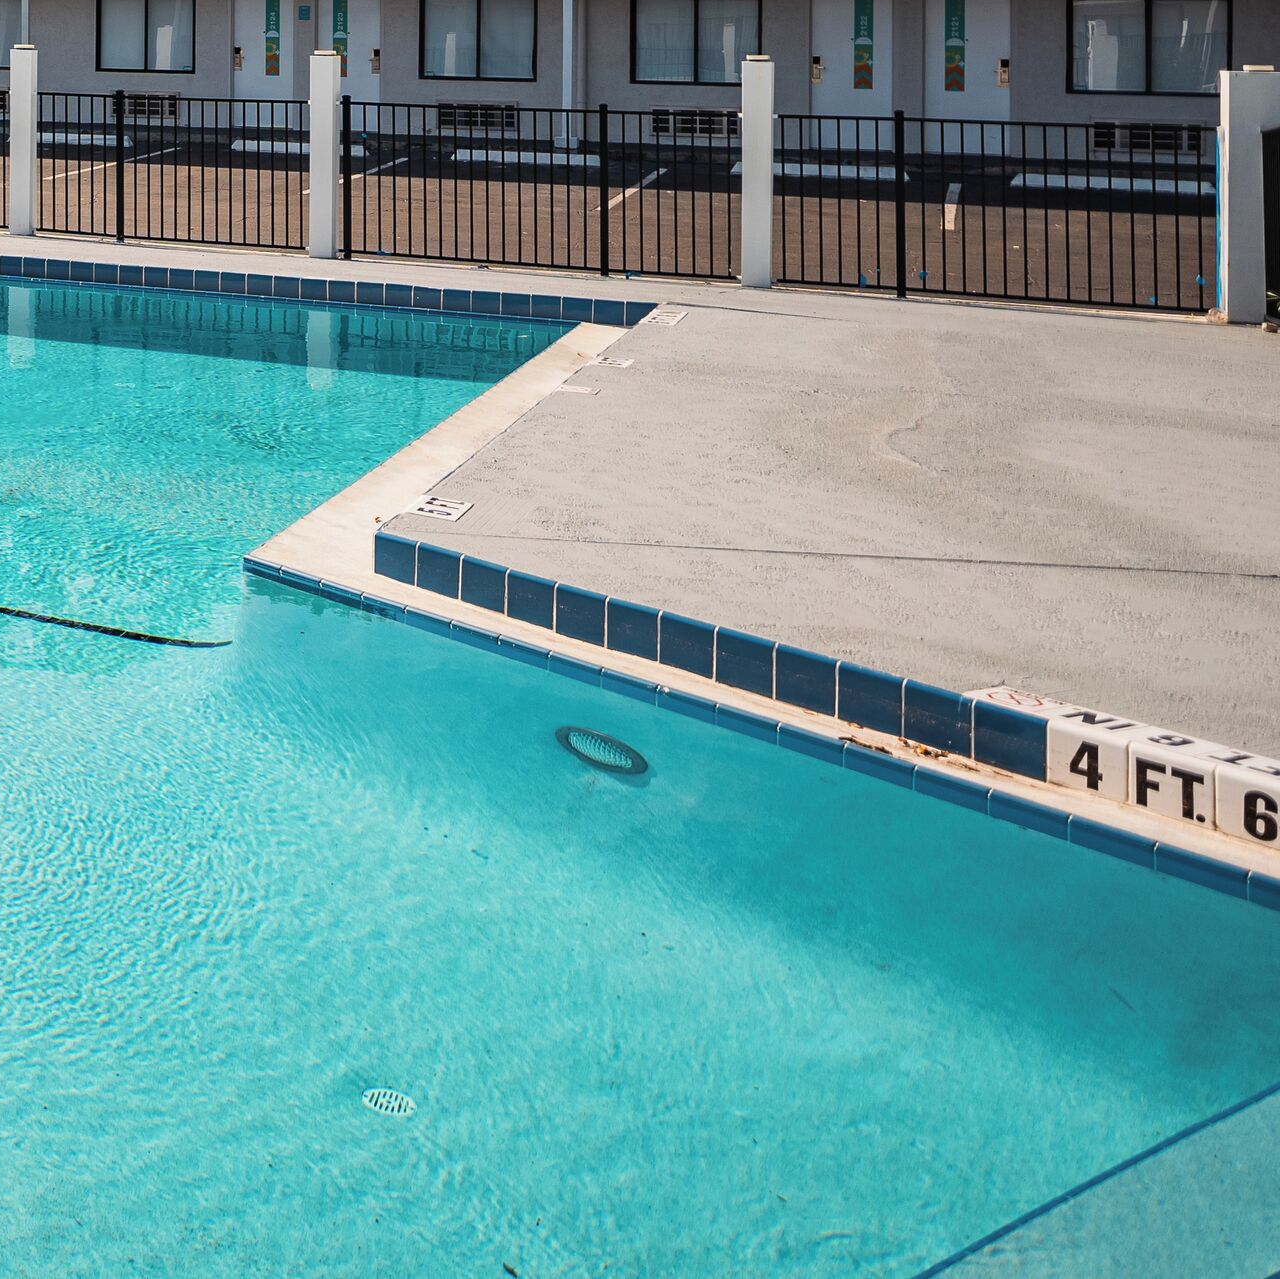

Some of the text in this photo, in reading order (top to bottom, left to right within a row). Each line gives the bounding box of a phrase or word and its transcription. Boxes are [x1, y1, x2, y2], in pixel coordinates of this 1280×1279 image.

[1069, 740, 1278, 842] 4 FT. 6
